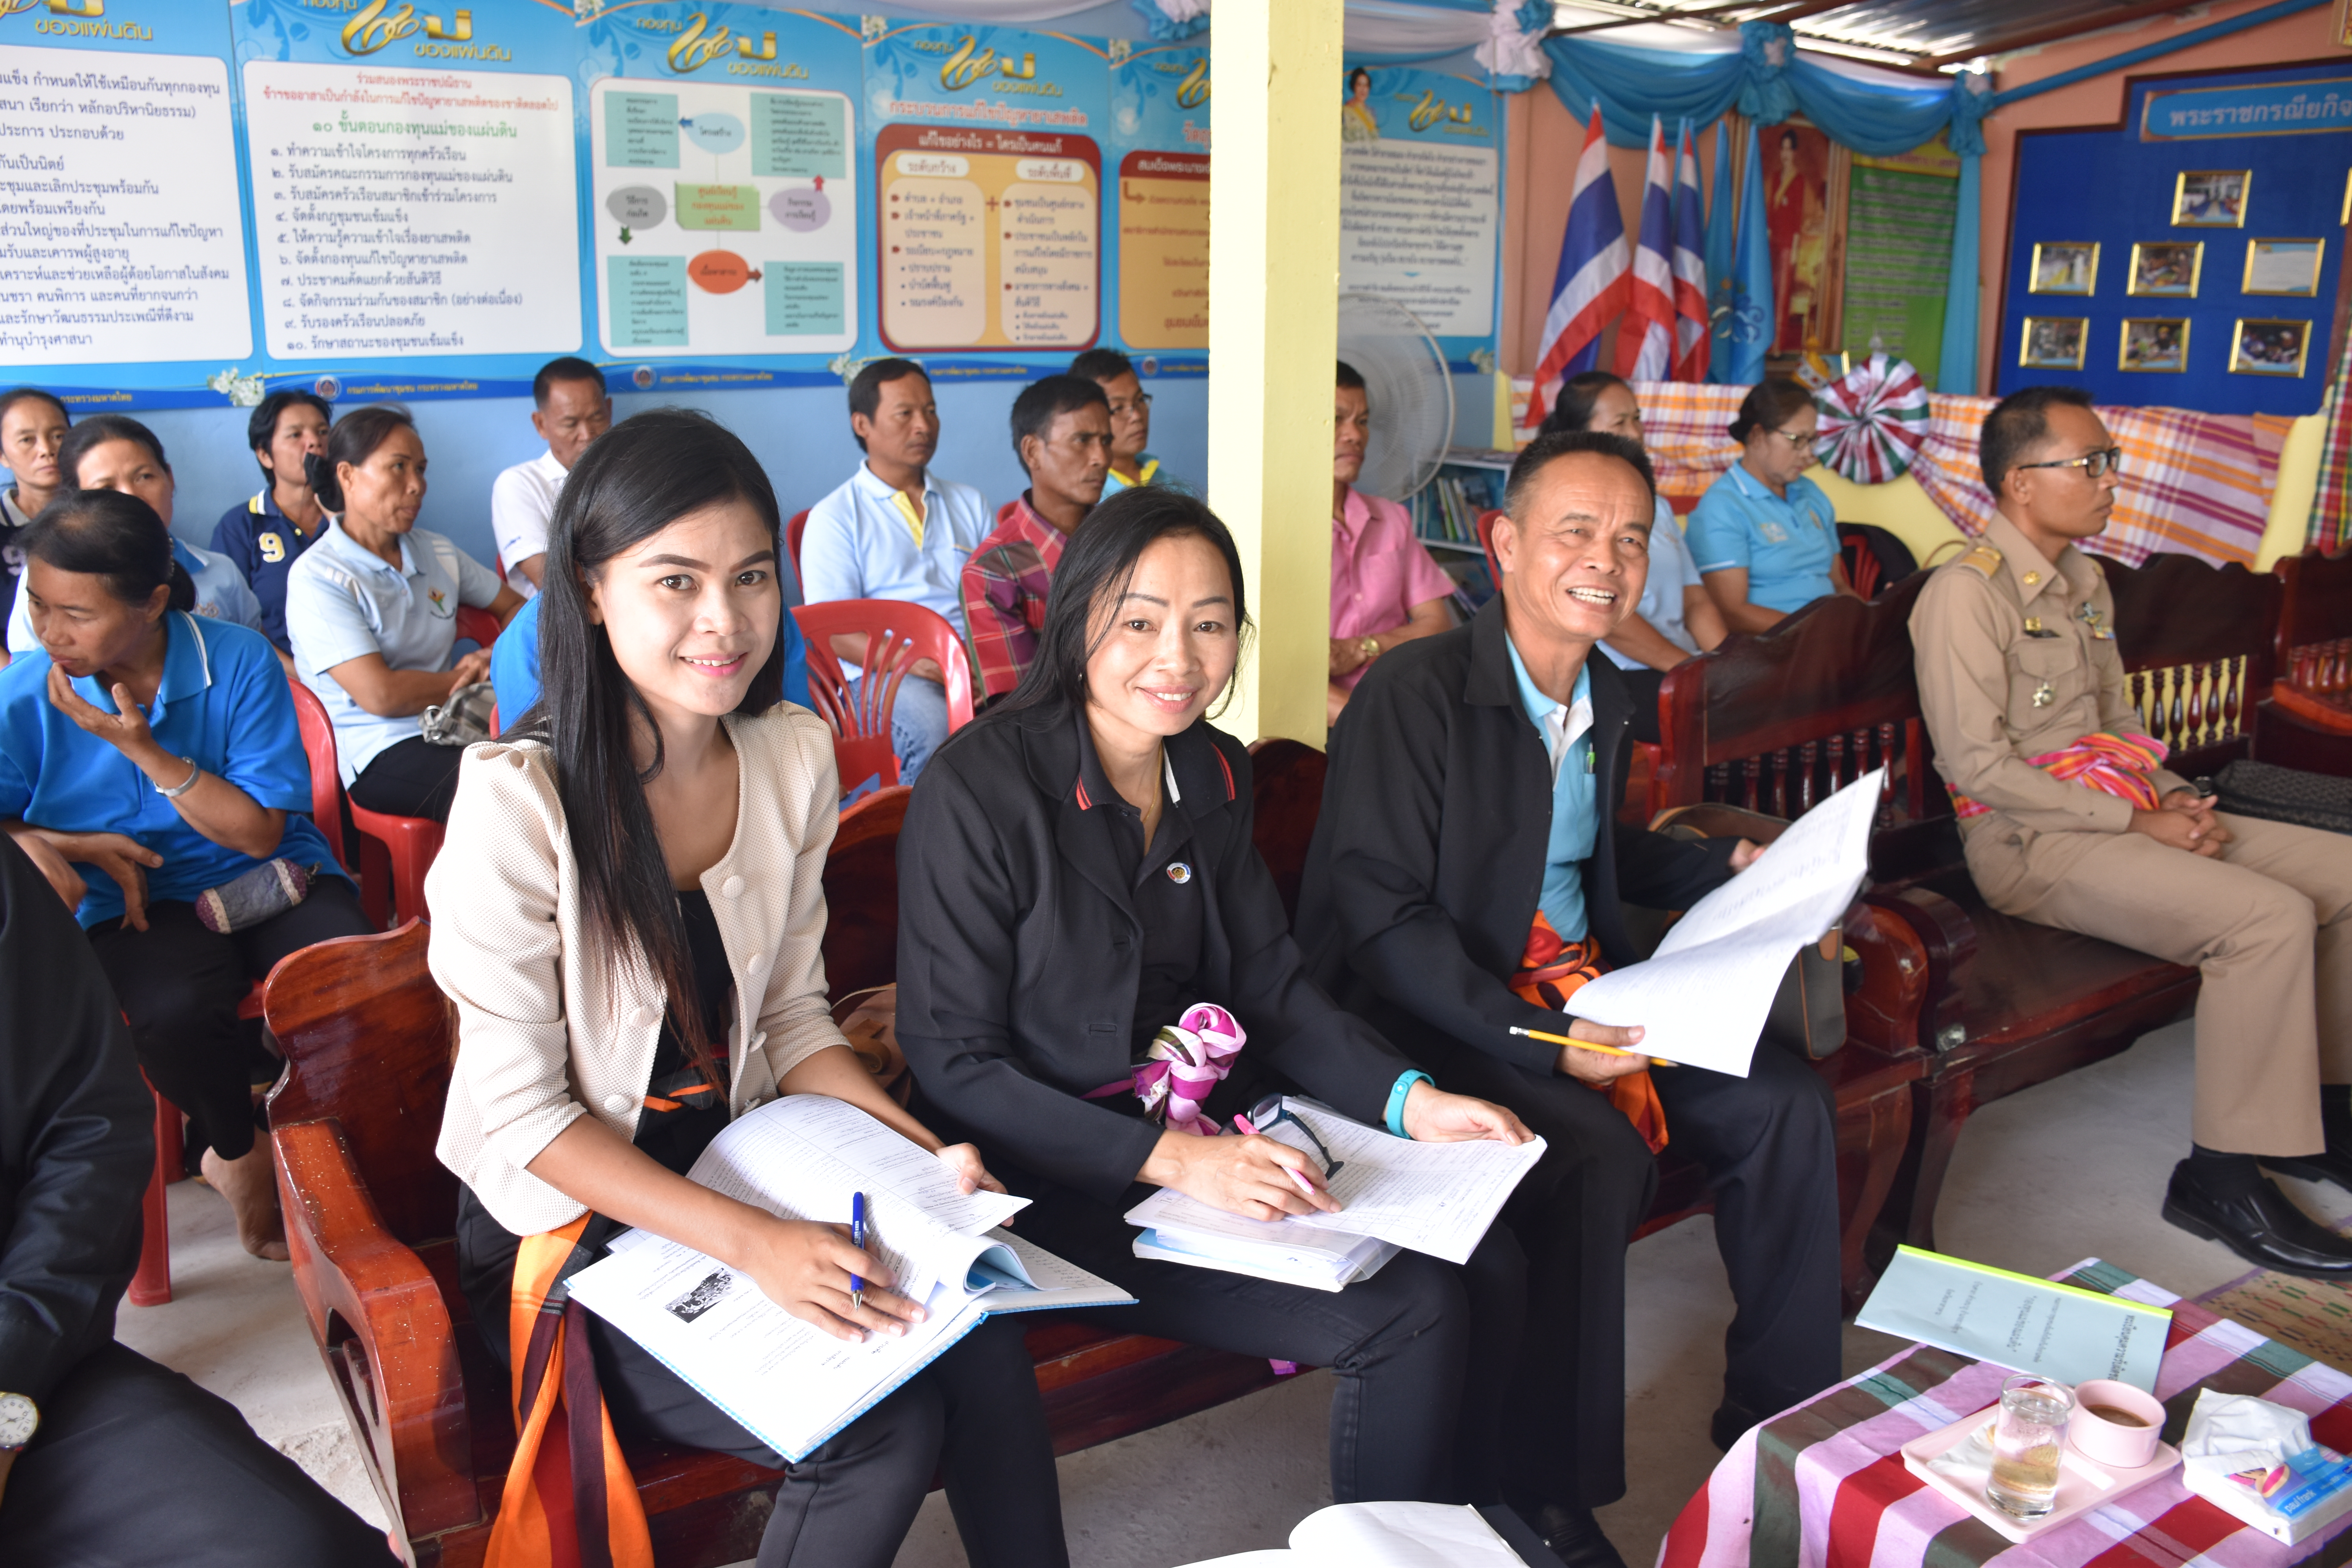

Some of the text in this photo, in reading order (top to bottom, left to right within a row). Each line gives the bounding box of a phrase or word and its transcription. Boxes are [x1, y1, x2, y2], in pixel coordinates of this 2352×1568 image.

[34, 71, 220, 98] กำหนดให้ใช้เหมือนกันทุกกองทุน
[30, 97, 74, 113] เรียกว่า
[78, 99, 196, 118] หลักอปริหานิยธรรม)
[49, 124, 124, 140] ประกอบด้วย
[313, 110, 517, 140] ๑๐ ขั้นตอนกองทุนแม่ของแผ่นดิน
[0, 199, 105, 215] ดยพร้อมเพรียงกัน
[38, 287, 85, 301] คนพิการ
[91, 286, 198, 302] และคนที่ยากจนกว่า
[259, 532, 285, 563] 9
[833, 1357, 849, 1369] งแผ่นดิน
[2285, 1489, 2316, 1514] paul frank
